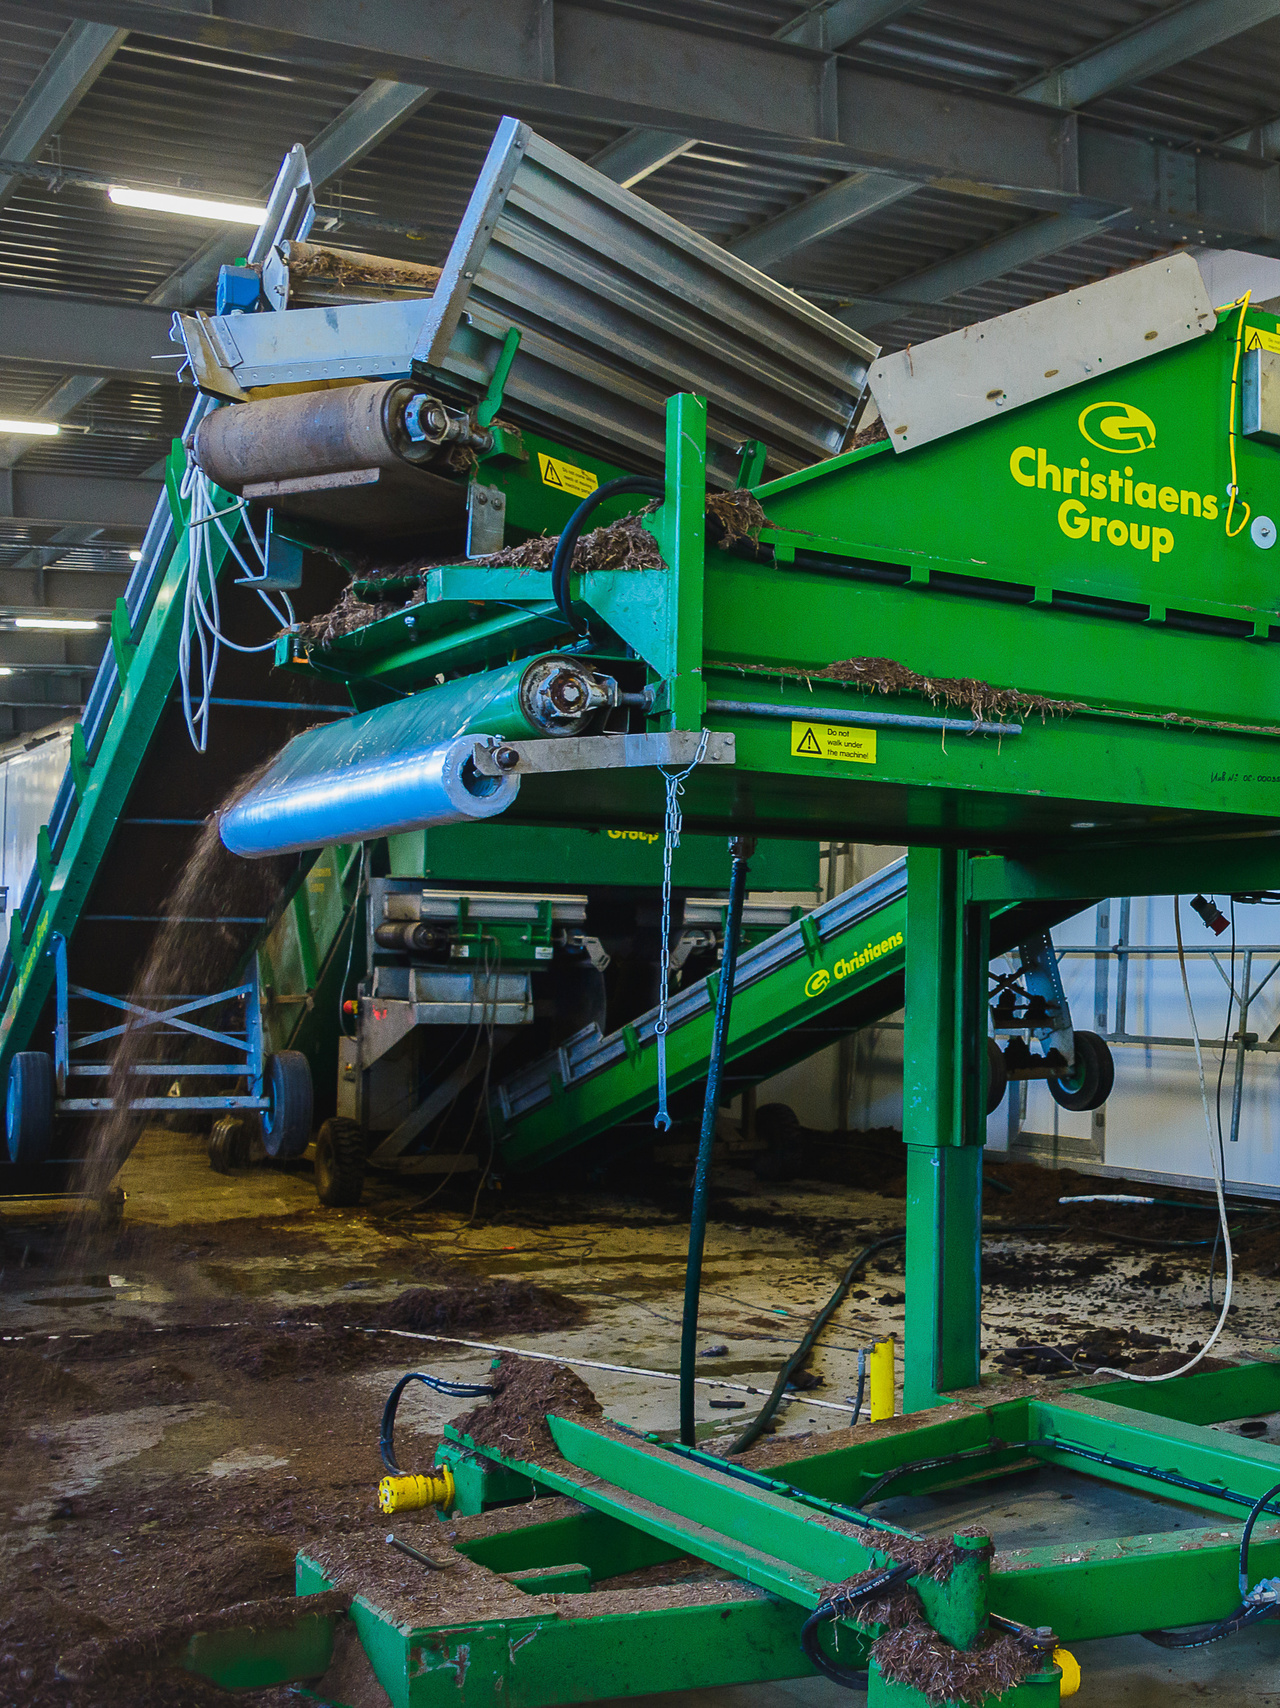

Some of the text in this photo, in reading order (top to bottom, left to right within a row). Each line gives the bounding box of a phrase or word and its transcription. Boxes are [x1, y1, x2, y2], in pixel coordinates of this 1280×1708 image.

[1009, 446, 1218, 520] Christiaens
[1057, 498, 1175, 563] Group
[827, 728, 837, 736] Do
[827, 739, 863, 749] walk under
[839, 750, 869, 760] machine!
[833, 931, 904, 980] Christiaens
